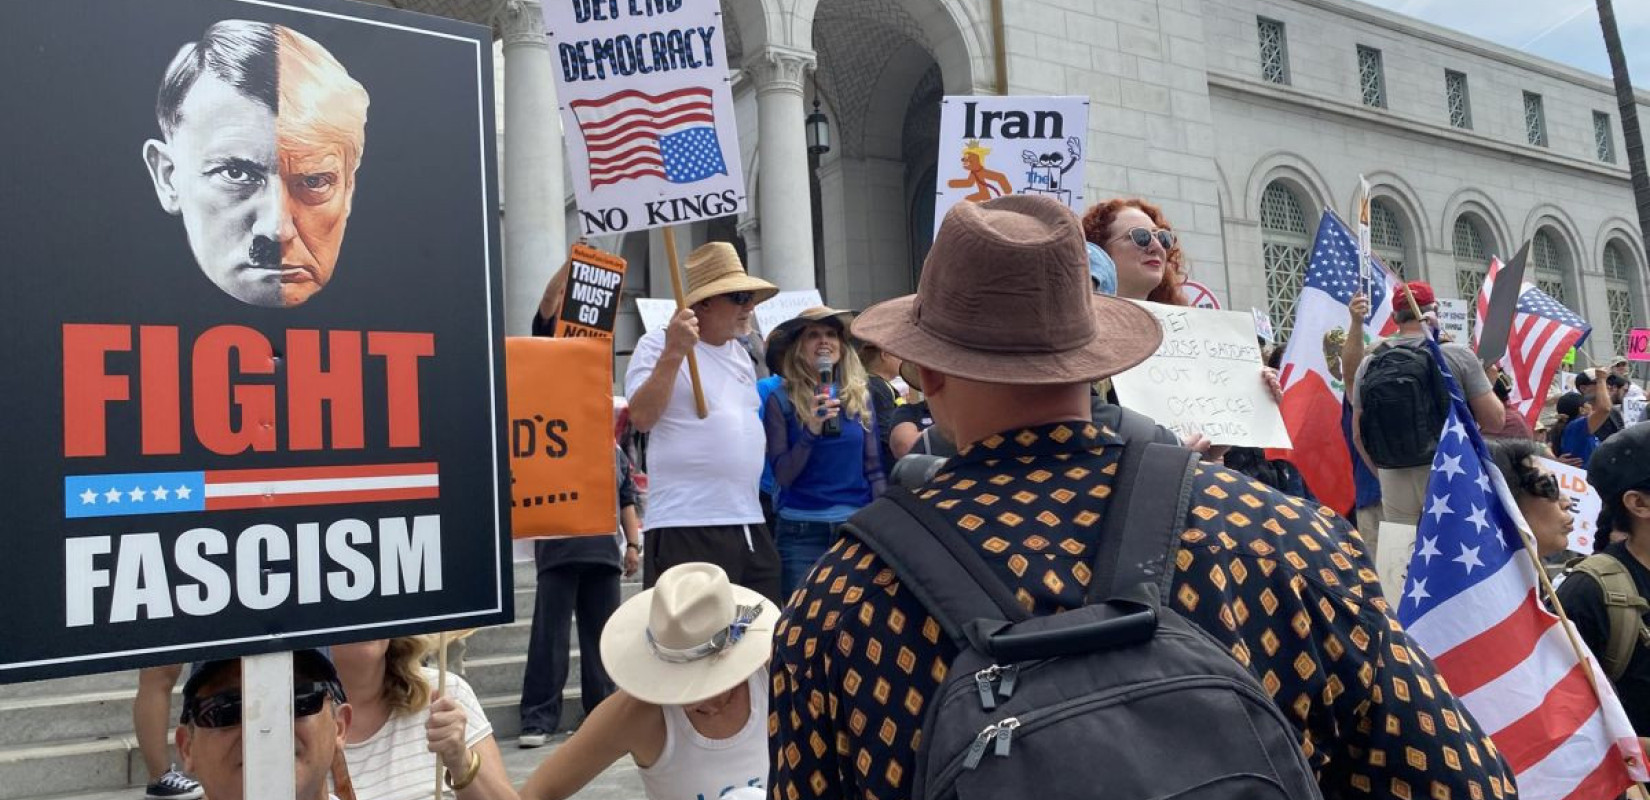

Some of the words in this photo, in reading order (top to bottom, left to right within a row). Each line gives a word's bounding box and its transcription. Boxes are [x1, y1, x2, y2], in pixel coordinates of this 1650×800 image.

[558, 26, 715, 82] DEMOCRACY
[963, 102, 1064, 139] Iran
[1026, 172, 1049, 184] The
[579, 207, 628, 235] NO
[645, 189, 738, 225] KINGS
[572, 261, 620, 290] TRUMP
[572, 282, 613, 308] MUST
[579, 304, 599, 325] GO
[1162, 311, 1190, 333] ET
[1630, 335, 1648, 353] NO
[1148, 365, 1191, 385] OUT
[1208, 368, 1230, 387] OF
[63, 323, 435, 457] FIGHT
[66, 514, 442, 627] FASCISM
